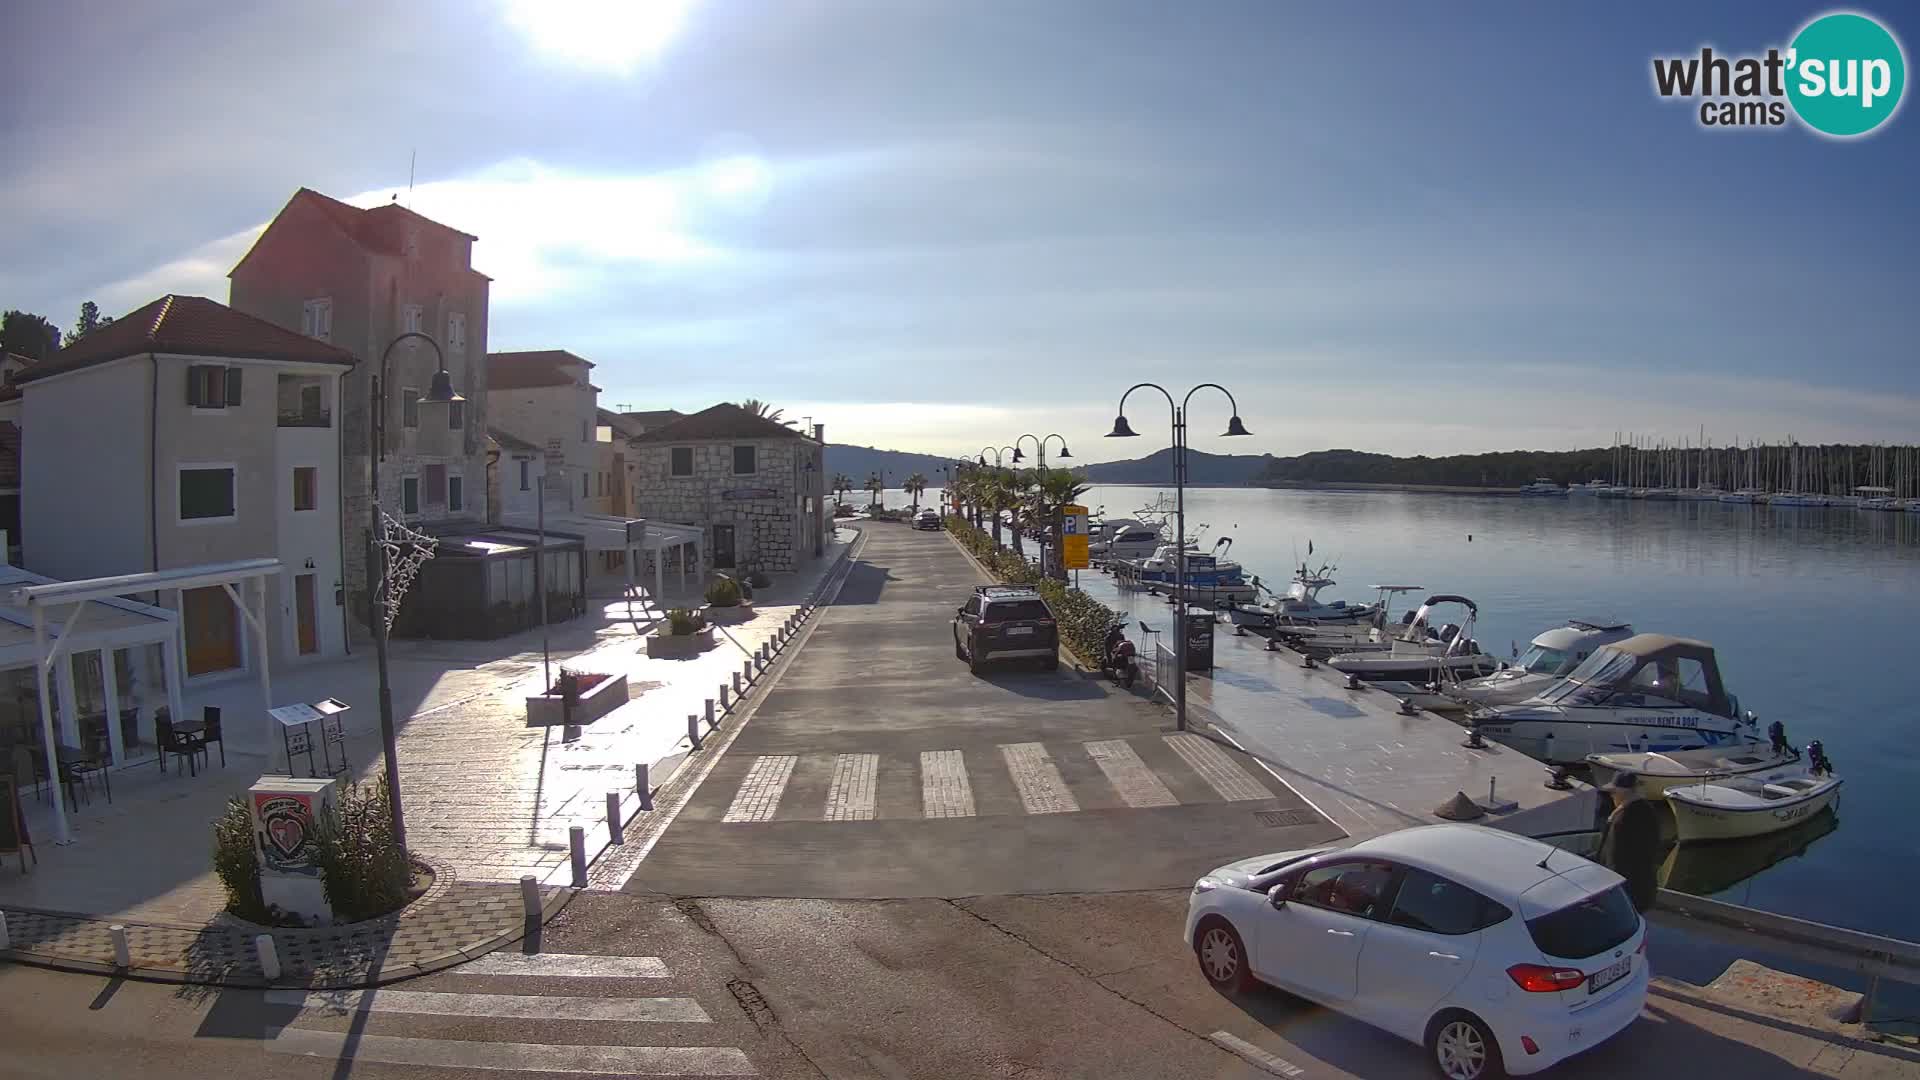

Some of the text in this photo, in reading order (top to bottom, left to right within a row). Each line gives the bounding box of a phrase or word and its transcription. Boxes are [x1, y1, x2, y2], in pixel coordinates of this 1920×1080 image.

[1065, 516, 1075, 532] P
[1657, 716, 1674, 726] RENT
[1682, 716, 1699, 727] BOAT
